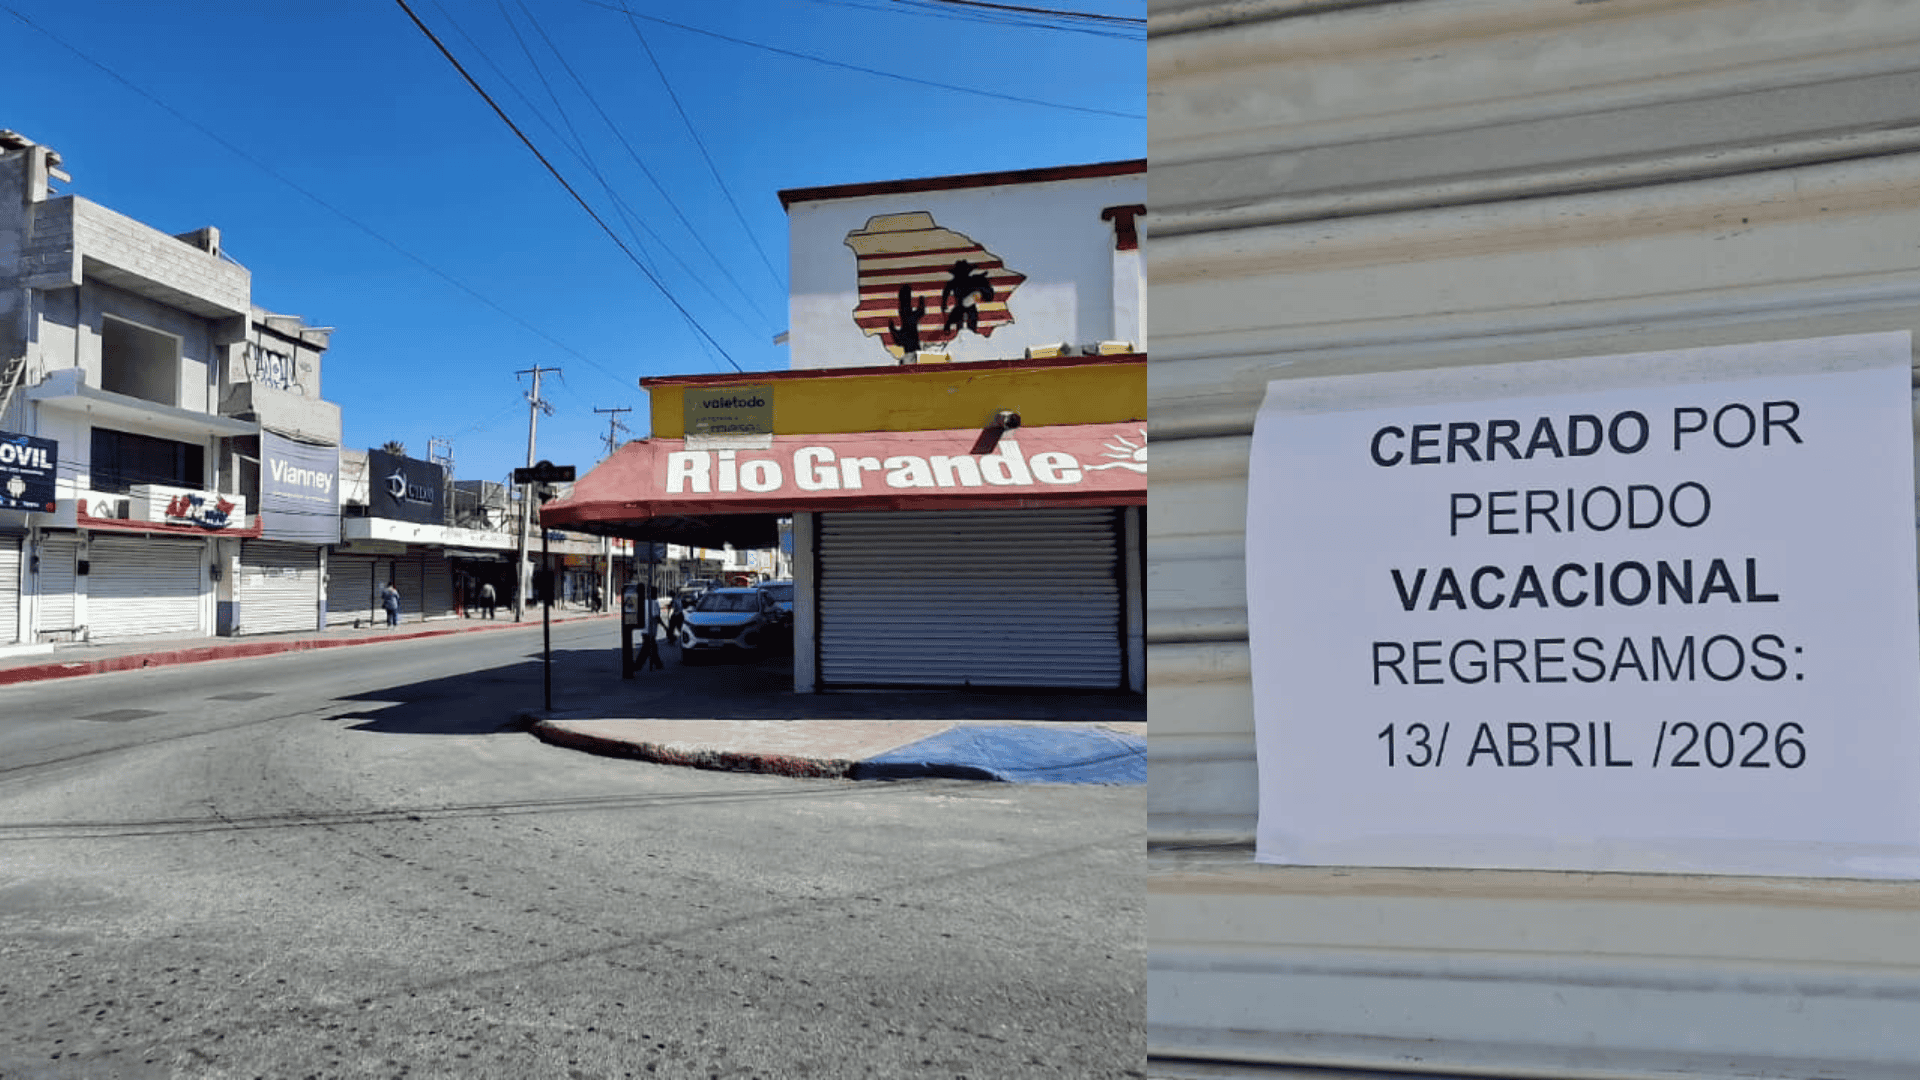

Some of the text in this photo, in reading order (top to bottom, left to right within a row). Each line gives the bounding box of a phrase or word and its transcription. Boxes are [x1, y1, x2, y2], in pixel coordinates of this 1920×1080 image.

[702, 395, 766, 409] valetodo
[1370, 400, 1804, 468] CERRADO POR
[269, 458, 334, 495] Vianney
[666, 441, 1083, 493] Rio Grande
[1450, 481, 1711, 537] PERIODO
[1390, 557, 1780, 612] VACACIONAL
[1372, 634, 1804, 686] REGRESAMOS:
[1378, 720, 1806, 769] 13/ ABRIL /2026
